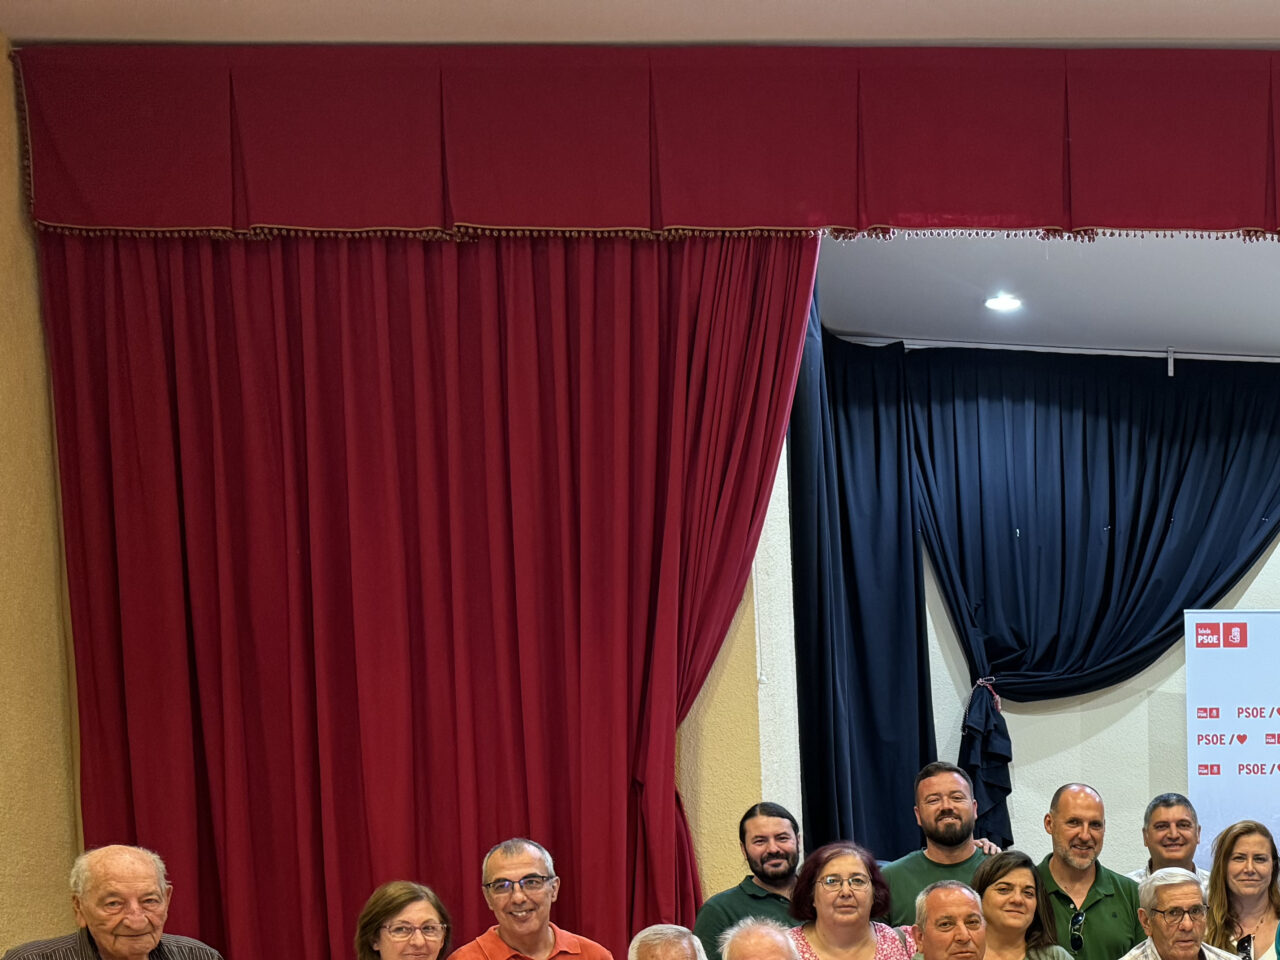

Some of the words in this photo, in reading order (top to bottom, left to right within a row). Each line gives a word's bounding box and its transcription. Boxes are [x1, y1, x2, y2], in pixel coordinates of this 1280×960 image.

[1198, 635, 1219, 644] PSOE
[1237, 707, 1266, 719] PSOE
[1197, 734, 1226, 745] PSOE
[1238, 763, 1267, 775] PSOE
